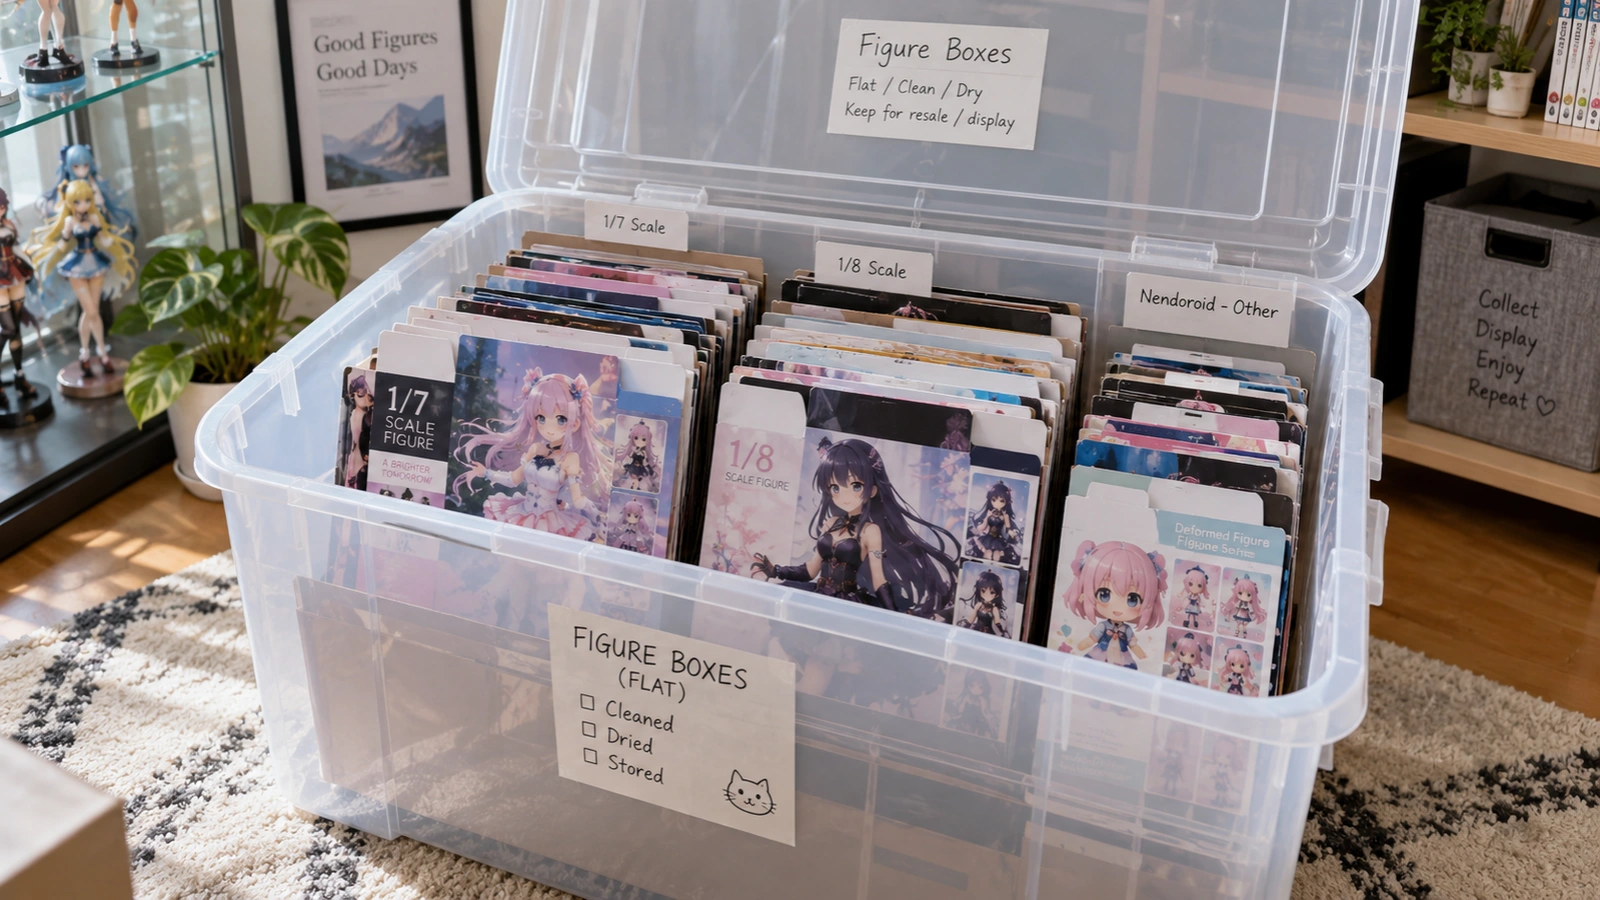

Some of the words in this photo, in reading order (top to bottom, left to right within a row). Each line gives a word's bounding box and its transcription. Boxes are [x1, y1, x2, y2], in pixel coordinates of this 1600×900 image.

[313, 31, 366, 54] Good
[371, 30, 439, 53] Figures
[858, 32, 931, 68] Figure
[945, 36, 1012, 64] Boxes
[316, 59, 368, 82] Good
[373, 57, 418, 81] Days
[848, 75, 878, 92] Flat
[897, 79, 936, 95] Clean
[956, 82, 984, 105] Dry
[844, 101, 877, 123] Keep
[882, 103, 904, 122] for
[908, 107, 949, 123] resale
[967, 111, 1016, 135] display
[603, 213, 625, 229] 1/7
[631, 216, 666, 235] Scale
[837, 256, 862, 274] 1/8
[868, 259, 907, 280] Scale
[1139, 288, 1217, 312] Nendoroid
[1233, 299, 1279, 319] Other
[1479, 288, 1541, 319] Collect
[1476, 318, 1538, 358] Display
[1476, 349, 1525, 385] Enjoy
[387, 385, 430, 417] 1/7
[1467, 377, 1529, 411] Repeat
[383, 430, 435, 451] FIGURE
[385, 415, 436, 437] SCALE
[382, 459, 389, 467] A
[391, 460, 430, 473] BRIGHTER
[729, 439, 775, 474] 1/8
[381, 469, 434, 485] TOMORROW
[725, 471, 755, 486] SCALE
[755, 476, 790, 492] FIGURE
[1175, 522, 1230, 541] Deformed
[1233, 531, 1270, 548] Figure
[573, 625, 658, 666] FIGURE
[671, 649, 748, 690] BOXES
[617, 666, 687, 704] (FLAT)
[605, 699, 675, 734] Cleaned
[606, 726, 654, 755] Dried
[608, 754, 665, 785] Stored
